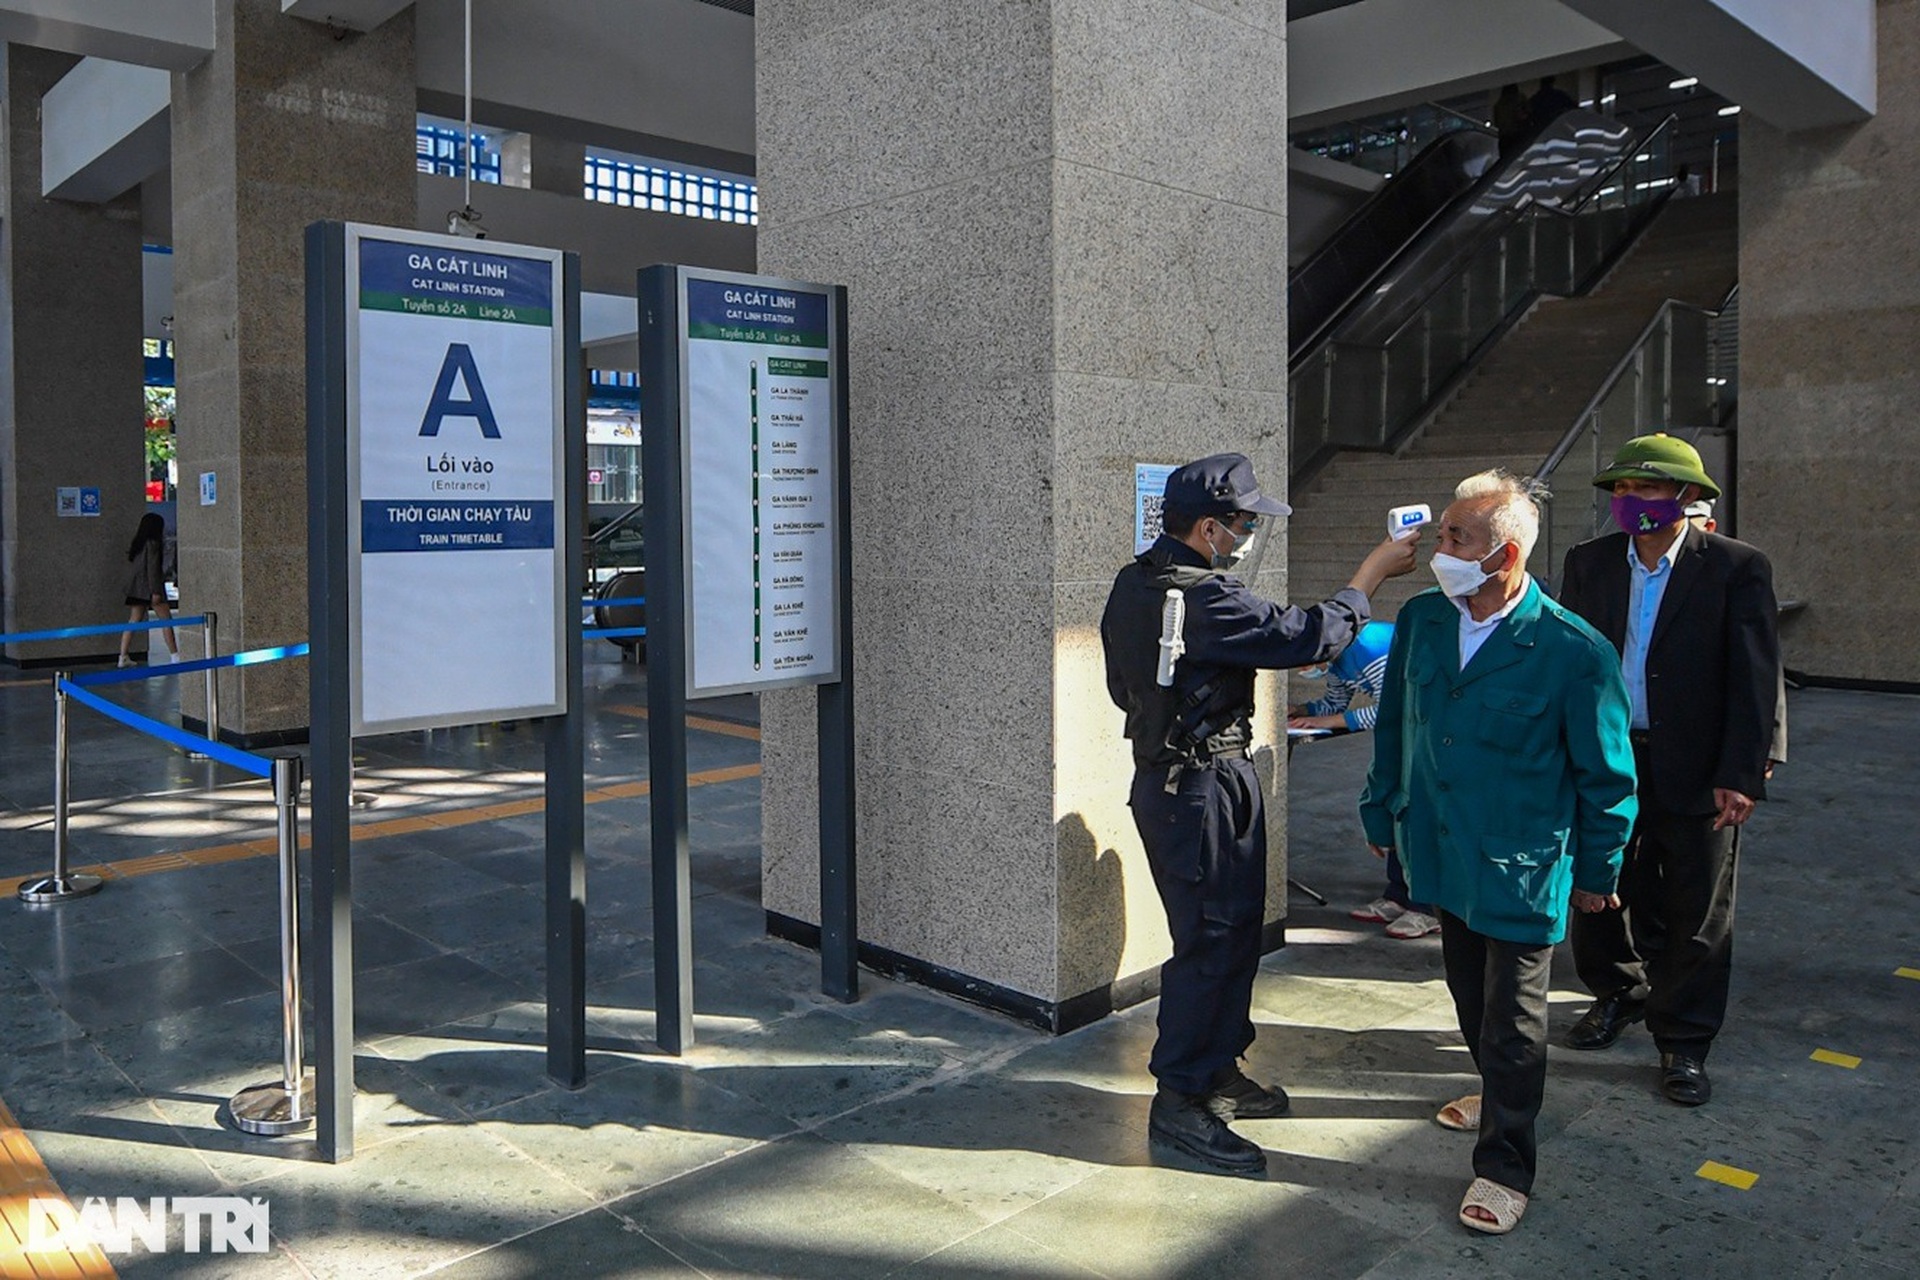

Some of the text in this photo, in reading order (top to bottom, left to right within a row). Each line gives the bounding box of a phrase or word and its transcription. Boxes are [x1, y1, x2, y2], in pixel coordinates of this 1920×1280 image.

[408, 254, 508, 279] GA CÁT LINH
[412, 279, 505, 297] CAT LINH STATION
[402, 298, 435, 313] Tuyến
[452, 303, 467, 315] 2A
[724, 290, 796, 309] GA CÁT LINH
[479, 307, 517, 320] Line 2A
[726, 309, 795, 324] CAT LINH STATION
[755, 331, 767, 341] 2A
[774, 333, 801, 344] Line 2A
[418, 342, 502, 439] A
[427, 452, 494, 474] Lối vào
[431, 480, 491, 492] (Entrance)
[387, 505, 532, 525] THỜI GIAN CHẠY TÀU
[773, 522, 781, 530] GA
[420, 533, 503, 545] TRAIN TIMETABLE
[773, 657, 782, 665] GA
